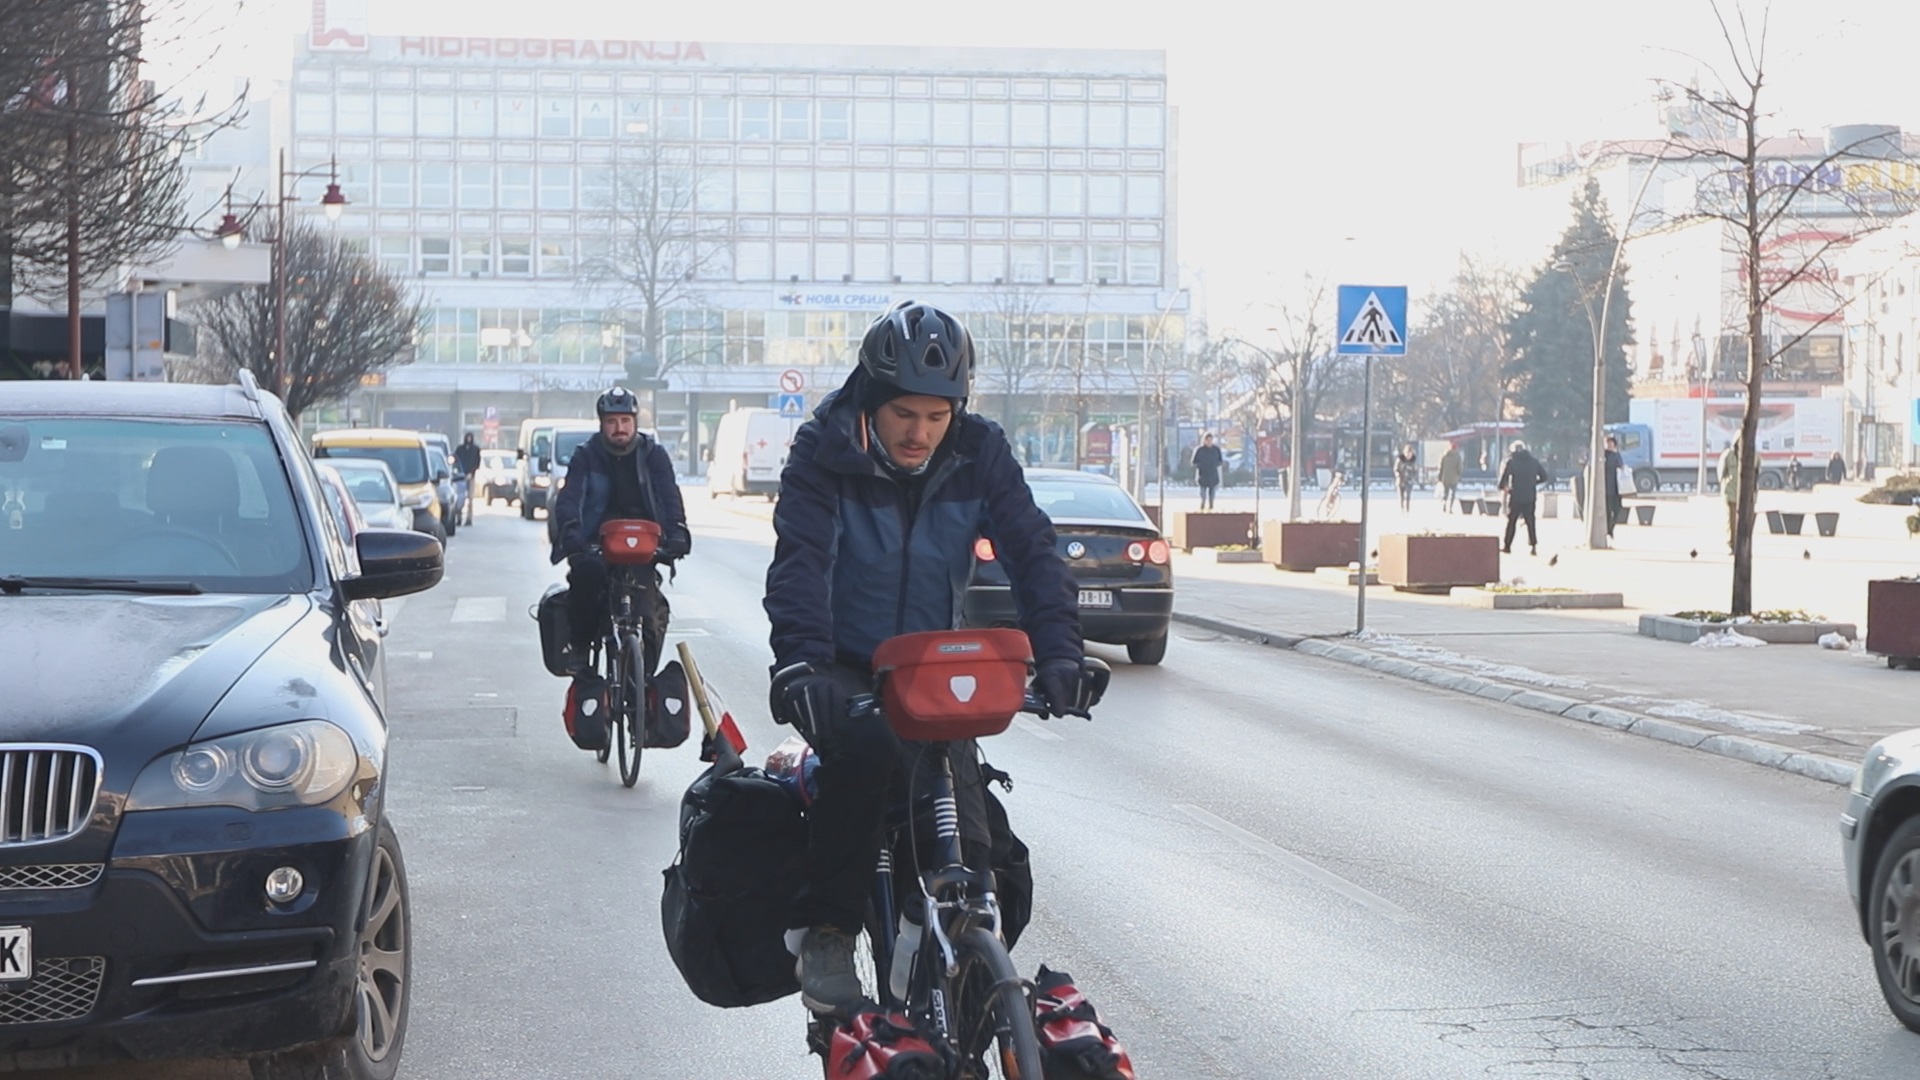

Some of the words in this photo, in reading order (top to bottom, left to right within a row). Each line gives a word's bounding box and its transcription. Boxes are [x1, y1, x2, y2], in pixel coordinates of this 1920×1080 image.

[400, 36, 706, 61] HIDROGRADNJA
[805, 294, 840, 305] НОВА
[844, 294, 890, 305] СРБИЈА
